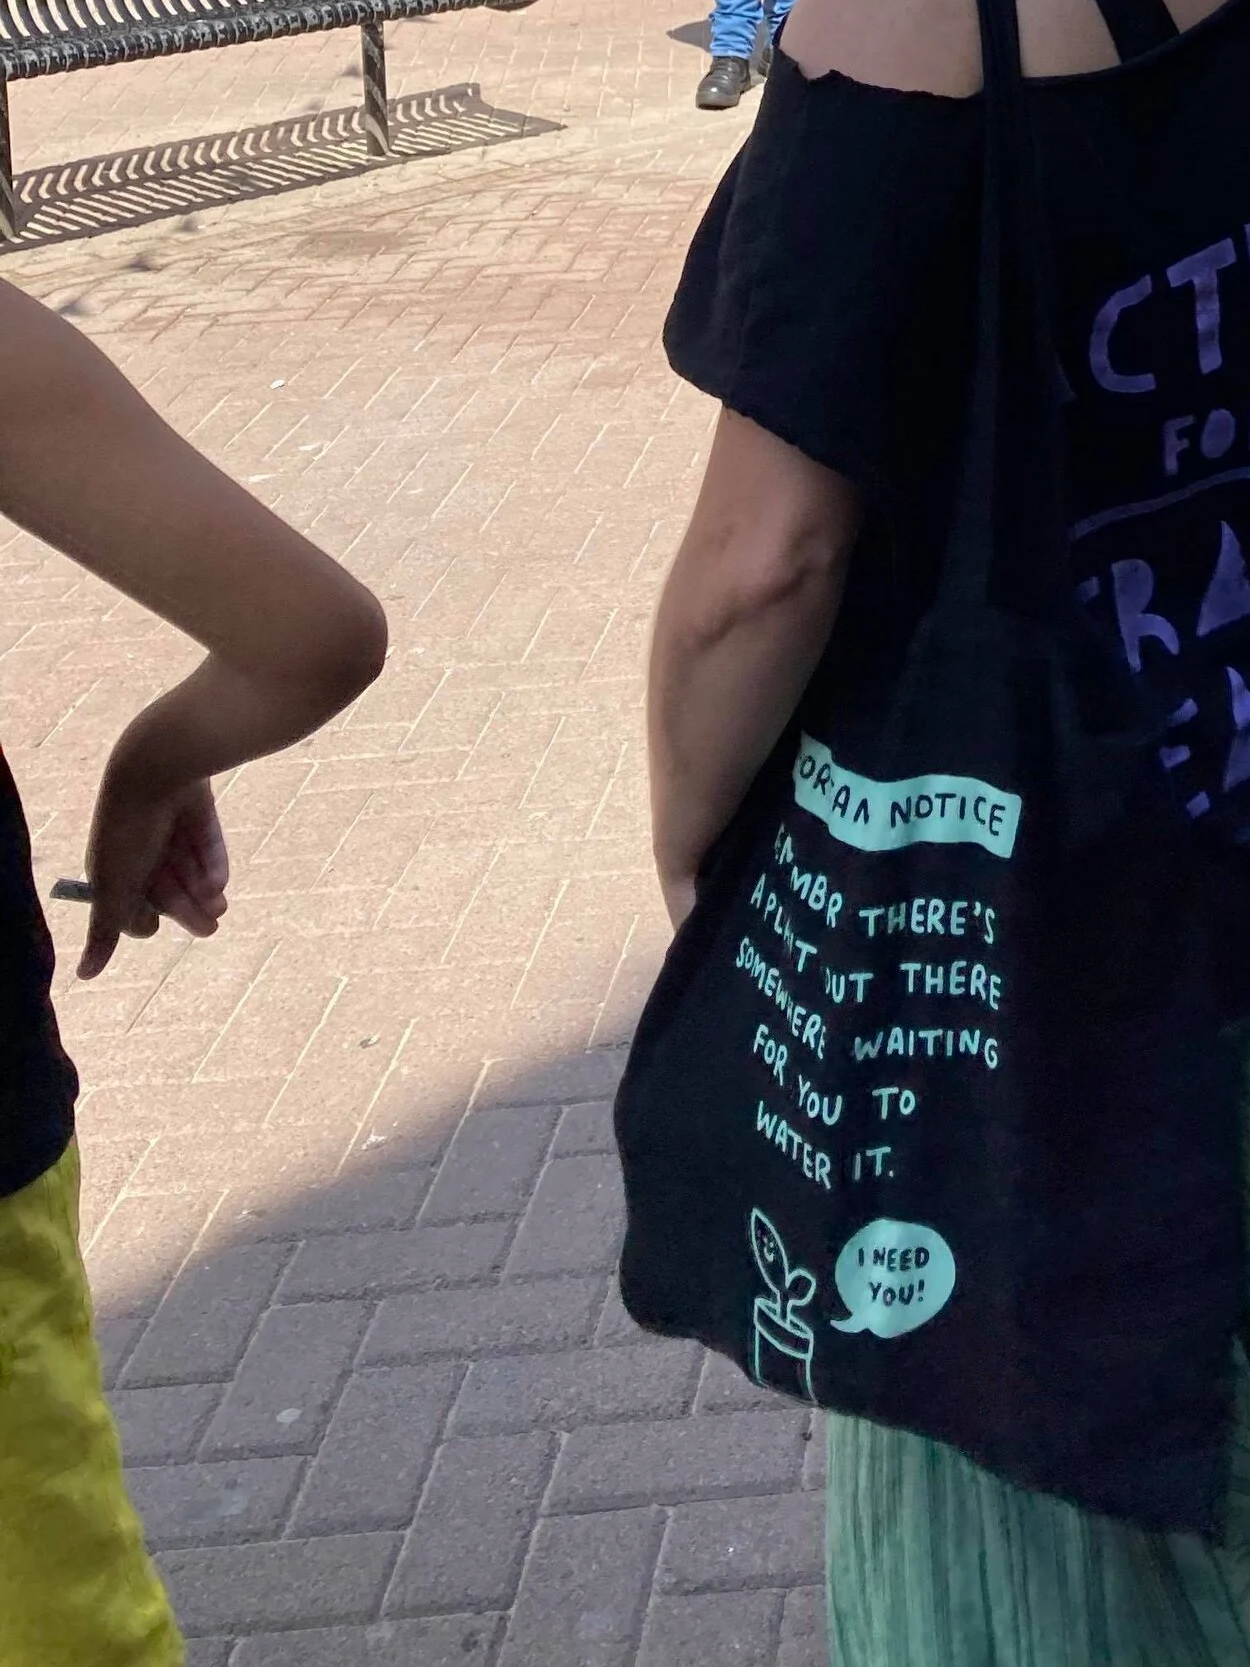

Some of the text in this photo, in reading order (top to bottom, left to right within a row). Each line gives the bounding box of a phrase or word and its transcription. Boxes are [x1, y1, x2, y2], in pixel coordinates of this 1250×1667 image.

[889, 792, 1007, 837] NOTICE
[750, 872, 767, 909] A
[900, 960, 1002, 1011] THERE
[858, 897, 997, 946] THERE'S
[853, 1026, 999, 1070] WAITING
[753, 1023, 916, 1126] FOR YOU TO
[755, 1100, 895, 1190] WATER IT.
[857, 1246, 931, 1273] I NEED
[868, 1278, 926, 1308] YOU!
